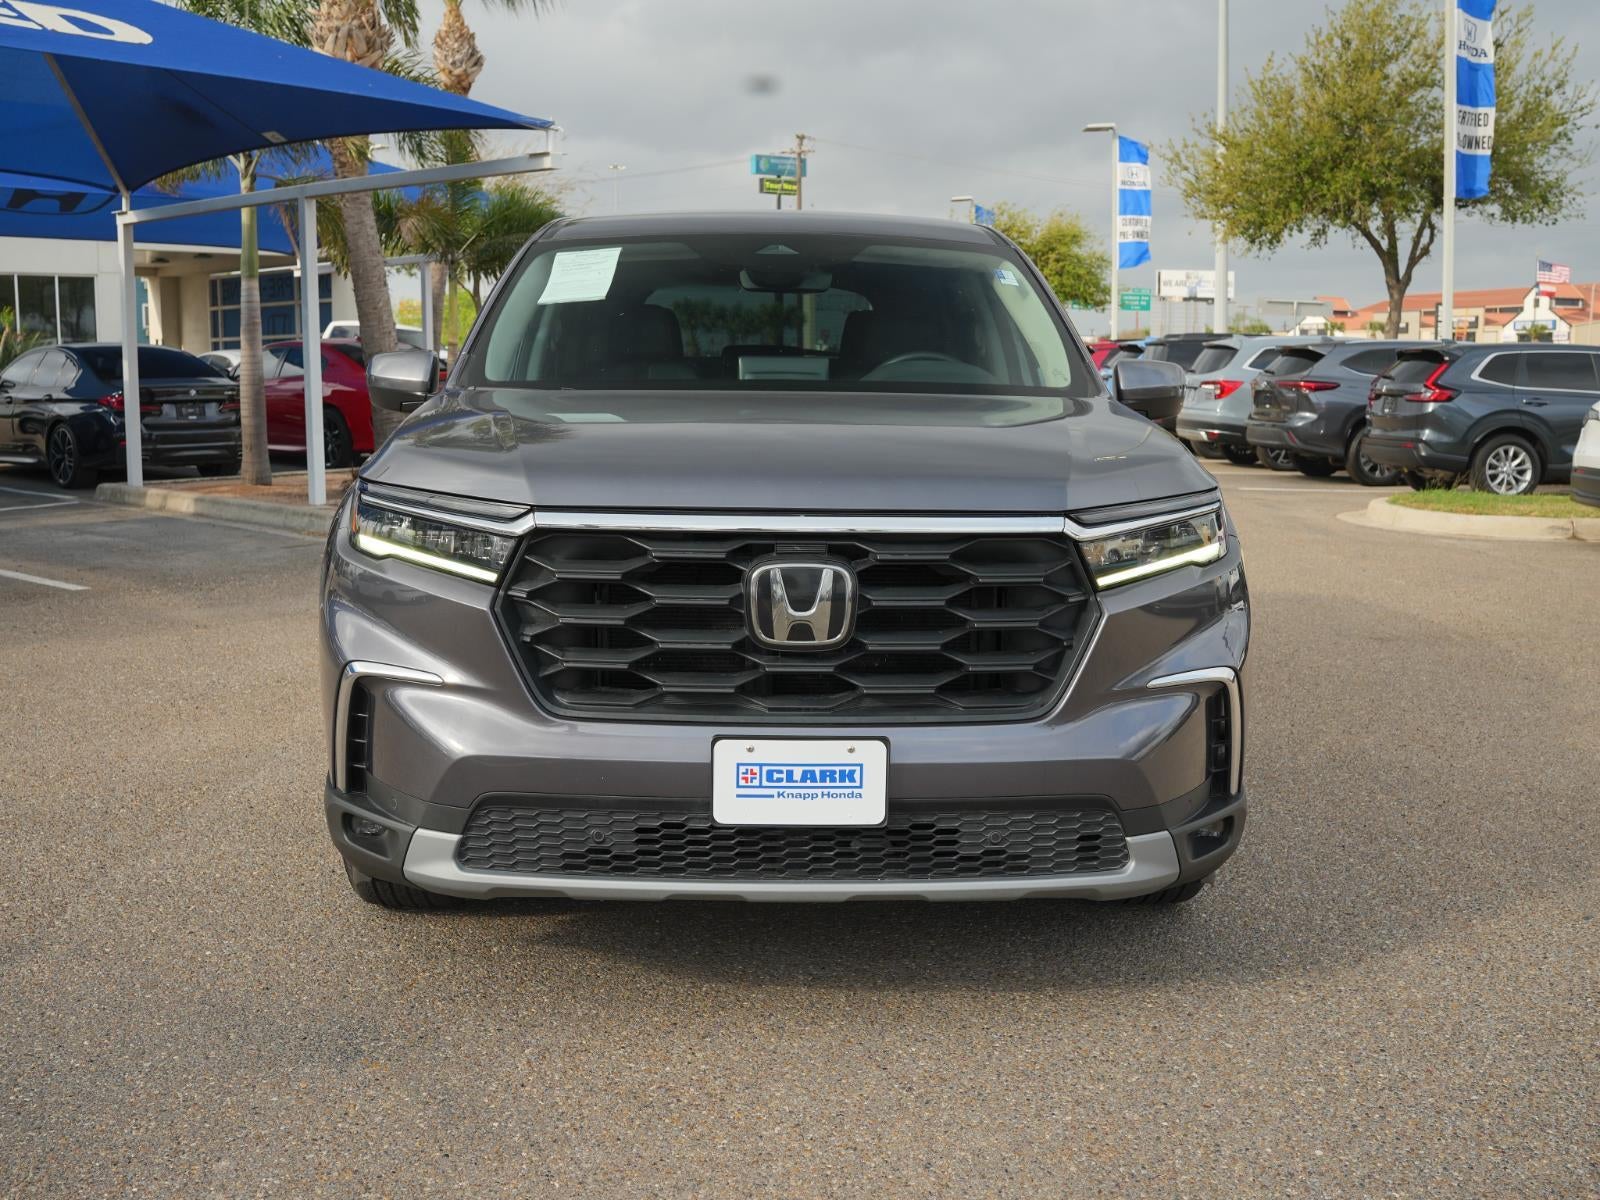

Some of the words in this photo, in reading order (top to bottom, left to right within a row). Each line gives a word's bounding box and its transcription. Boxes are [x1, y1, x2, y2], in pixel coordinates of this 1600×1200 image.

[1458, 40, 1488, 58] HDA
[1457, 132, 1493, 150] -OWNED
[766, 769, 857, 784] CLARK
[777, 790, 819, 801] Knapp
[821, 790, 863, 799] Honda
